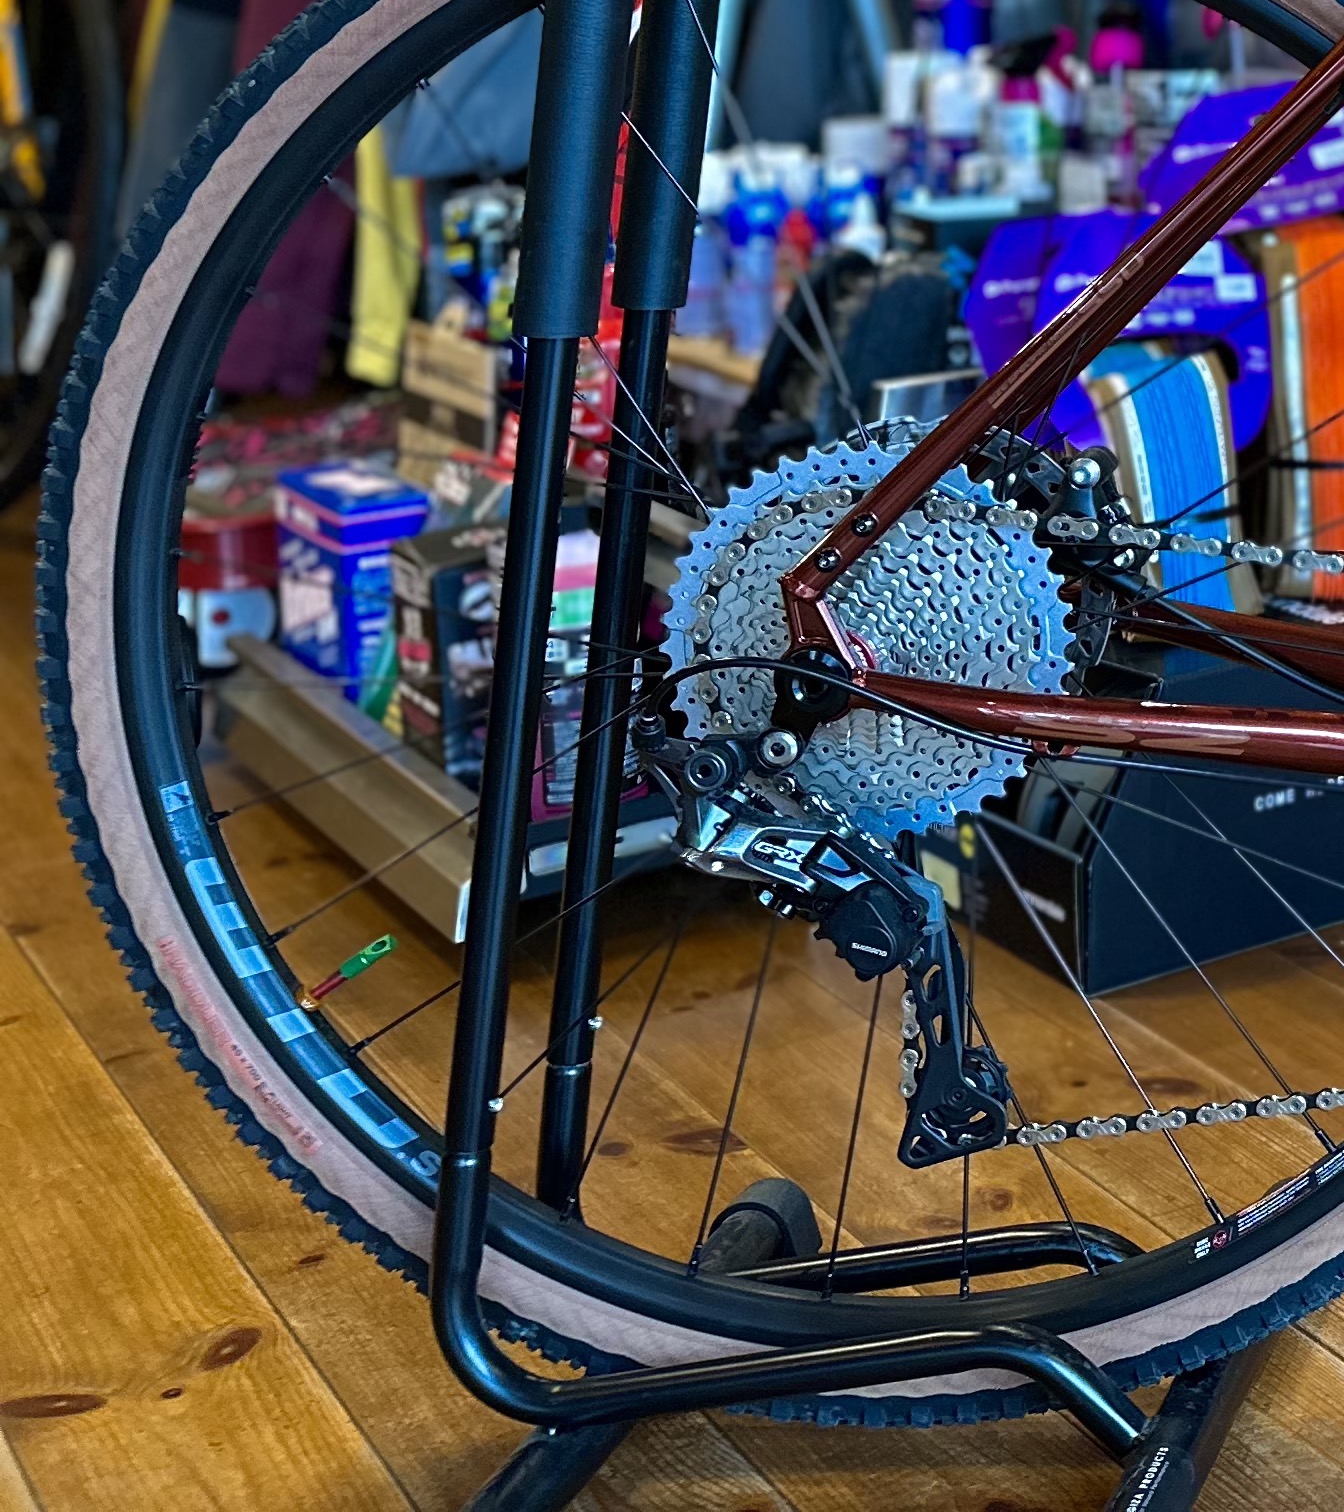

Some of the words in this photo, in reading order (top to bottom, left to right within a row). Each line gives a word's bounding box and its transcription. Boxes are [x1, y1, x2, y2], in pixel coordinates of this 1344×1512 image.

[1252, 787, 1295, 812] COME
[754, 840, 806, 864] GRX
[850, 942, 888, 957] SHIMANO
